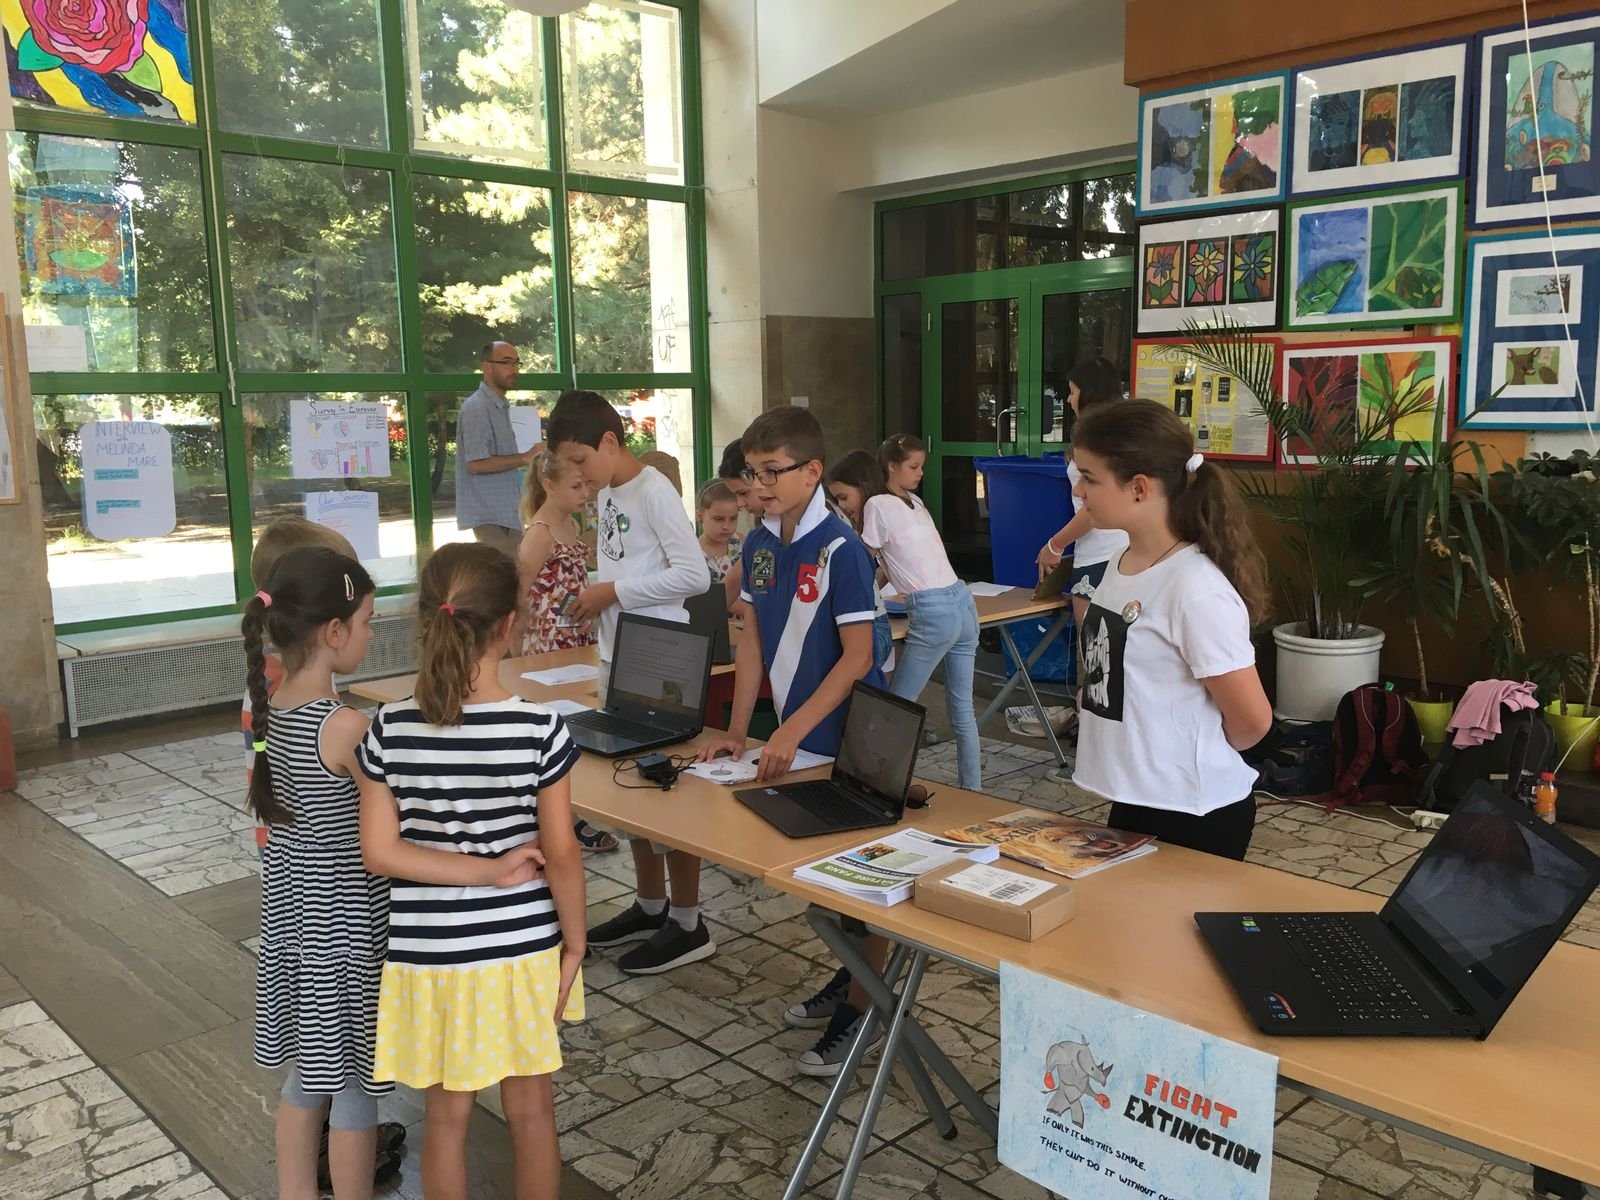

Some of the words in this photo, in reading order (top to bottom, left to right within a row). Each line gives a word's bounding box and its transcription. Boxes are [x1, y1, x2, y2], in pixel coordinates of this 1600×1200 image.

[95, 421, 161, 437] INTERVIEW
[96, 442, 146, 456] MELINDA
[127, 455, 160, 467] MARE
[796, 563, 819, 603] 5
[824, 864, 854, 877] FANS
[1144, 1073, 1238, 1129] FIGHT
[1042, 1115, 1050, 1124] IF
[1051, 1119, 1070, 1134] ONLY
[1080, 1134, 1095, 1146] WAS
[1095, 1141, 1113, 1154] THIS
[1123, 1094, 1261, 1174] EXTINCTION
[1040, 1136, 1064, 1153] THEY
[1087, 1159, 1100, 1171] DO
[1104, 1168, 1115, 1177] IT
[1119, 1175, 1156, 1197] WITHOUT
